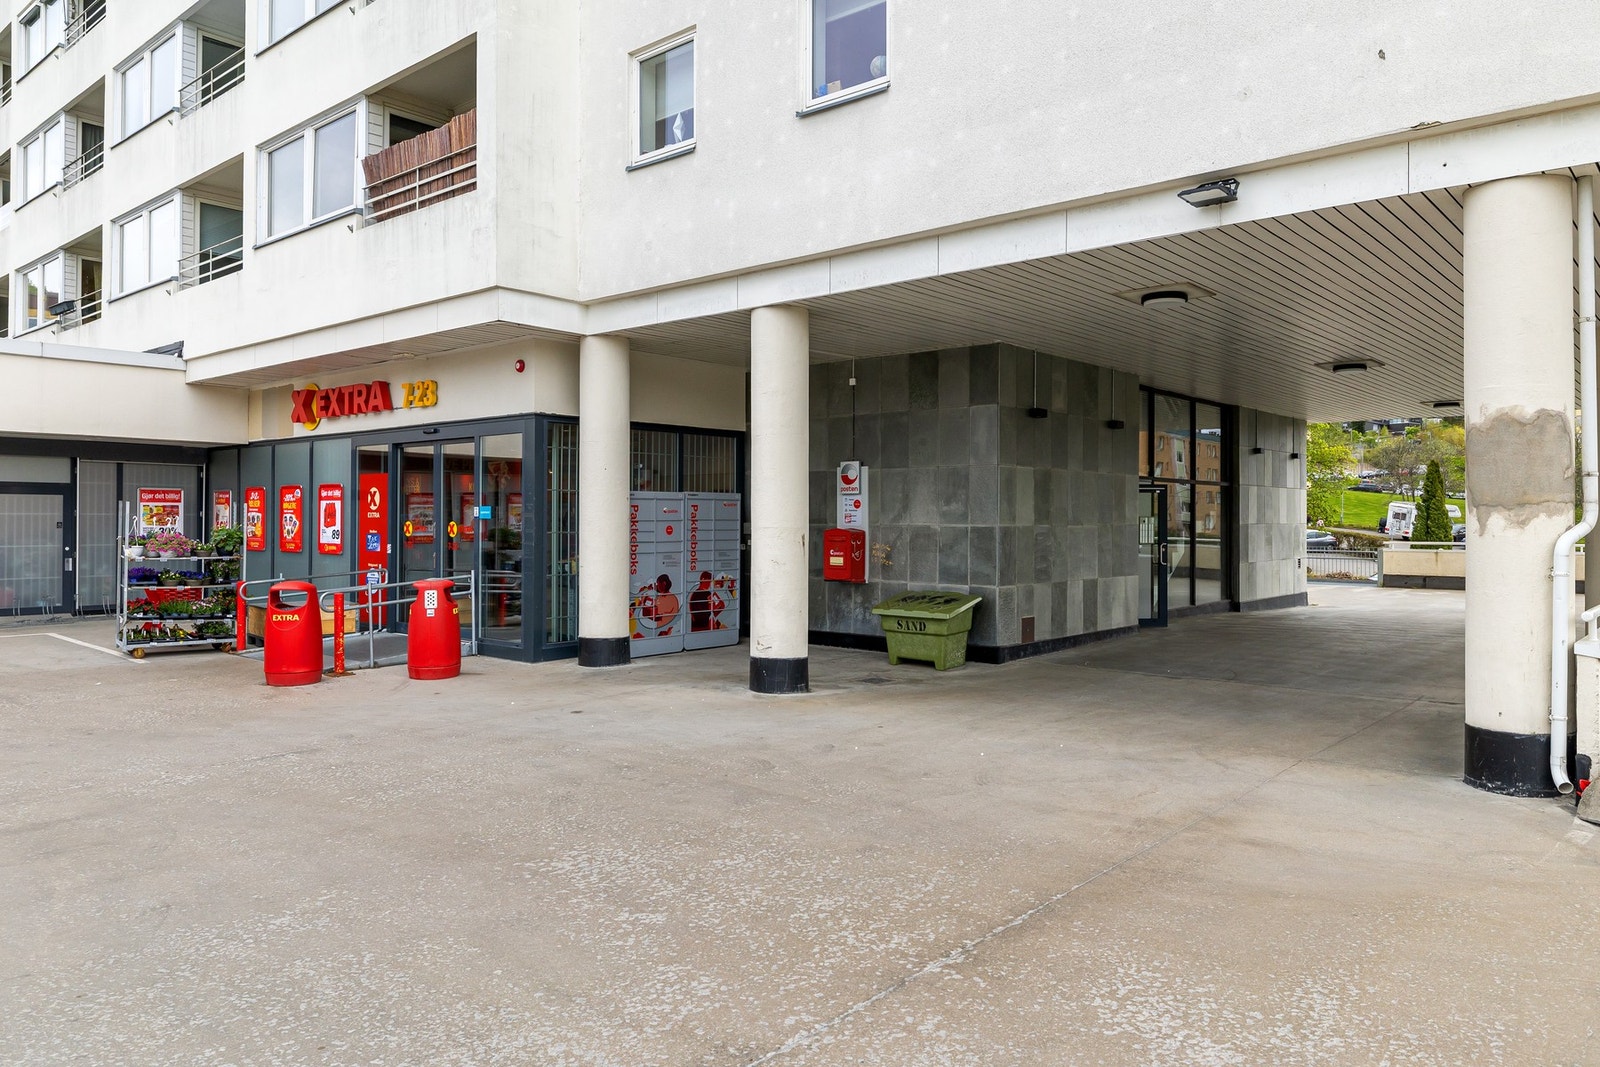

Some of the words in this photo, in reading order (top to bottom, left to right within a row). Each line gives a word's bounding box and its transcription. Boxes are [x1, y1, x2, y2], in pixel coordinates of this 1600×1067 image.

[316, 381, 392, 418] EXTRA
[402, 379, 438, 409] 7-23
[332, 530, 340, 540] 89
[630, 504, 639, 575] Pakkeboks
[690, 504, 698, 571] Pakkeboks
[272, 614, 300, 622] EXTRA
[897, 619, 927, 632] SAND
